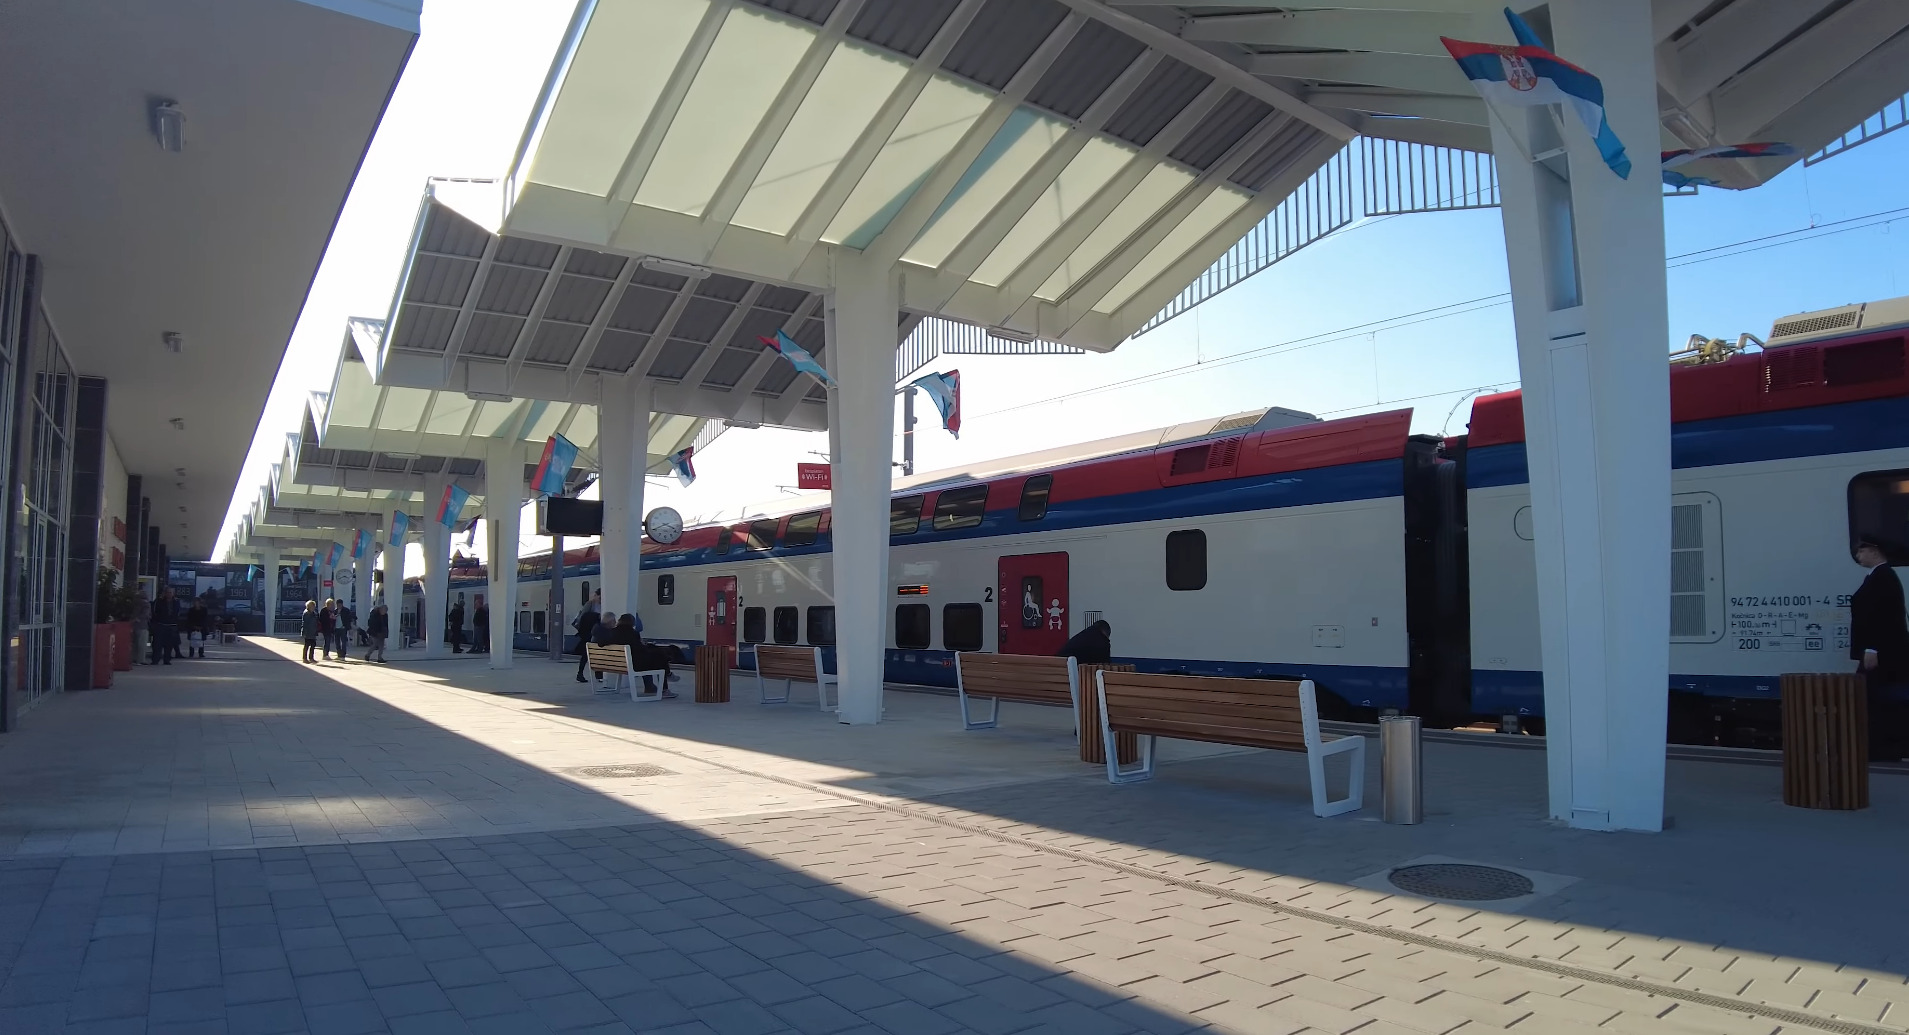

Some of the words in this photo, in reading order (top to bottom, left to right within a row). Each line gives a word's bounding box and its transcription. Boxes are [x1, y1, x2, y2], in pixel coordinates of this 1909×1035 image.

[805, 473, 824, 481] Wi-Fi
[230, 588, 248, 597] 1961
[984, 586, 993, 602] 2
[738, 595, 744, 607] 2
[1731, 597, 1744, 607] 94
[1745, 596, 1759, 607] 72
[1761, 596, 1768, 606] 4
[1770, 596, 1790, 606] 410
[1792, 595, 1812, 606] 001
[1738, 638, 1761, 650] 200
